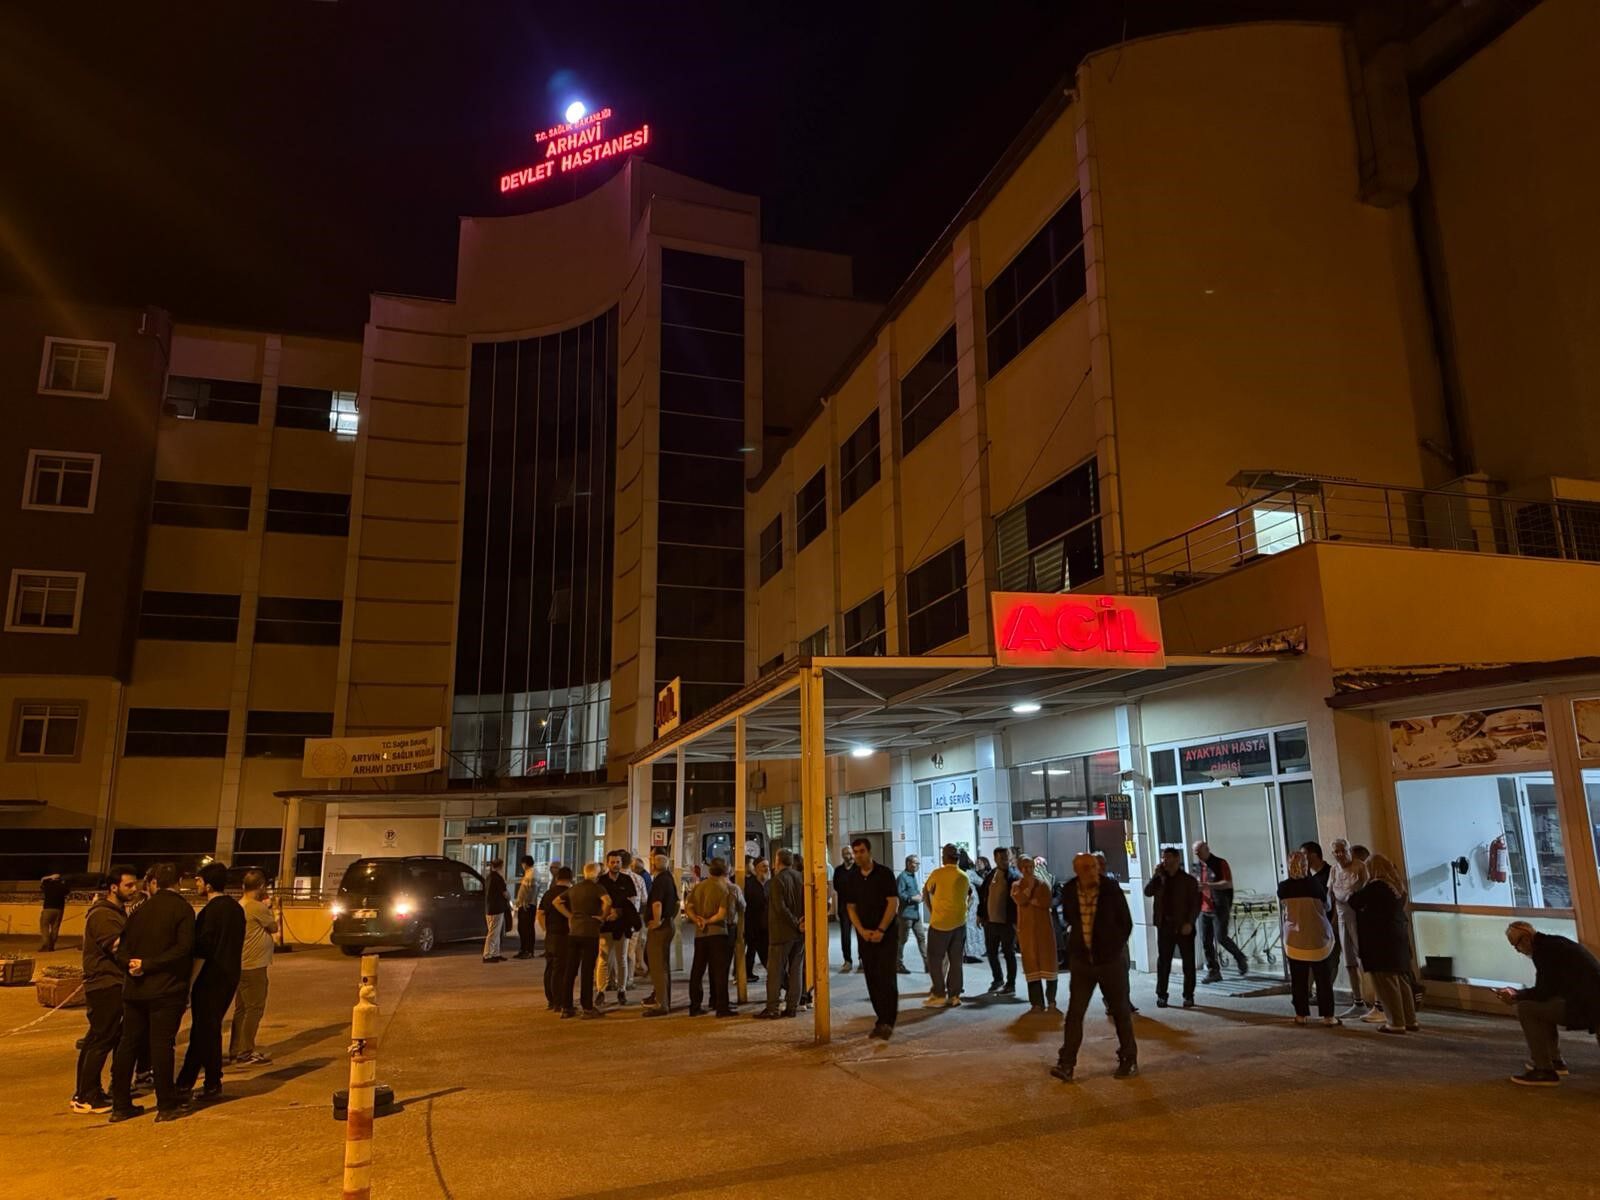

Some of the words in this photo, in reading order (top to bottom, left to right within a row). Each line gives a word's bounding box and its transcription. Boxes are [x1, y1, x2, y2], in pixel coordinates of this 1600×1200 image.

[546, 122, 601, 157] ARHAVİ
[501, 161, 554, 192] DEVLET
[562, 125, 648, 171] HASTANESİ
[1003, 596, 1159, 652] ACİL
[1185, 744, 1230, 761] AYAKTAN
[1231, 739, 1266, 755] HASTA
[385, 761, 412, 774] DEVLET
[949, 791, 972, 806] SERVİS
[710, 821, 733, 829] HASTA
